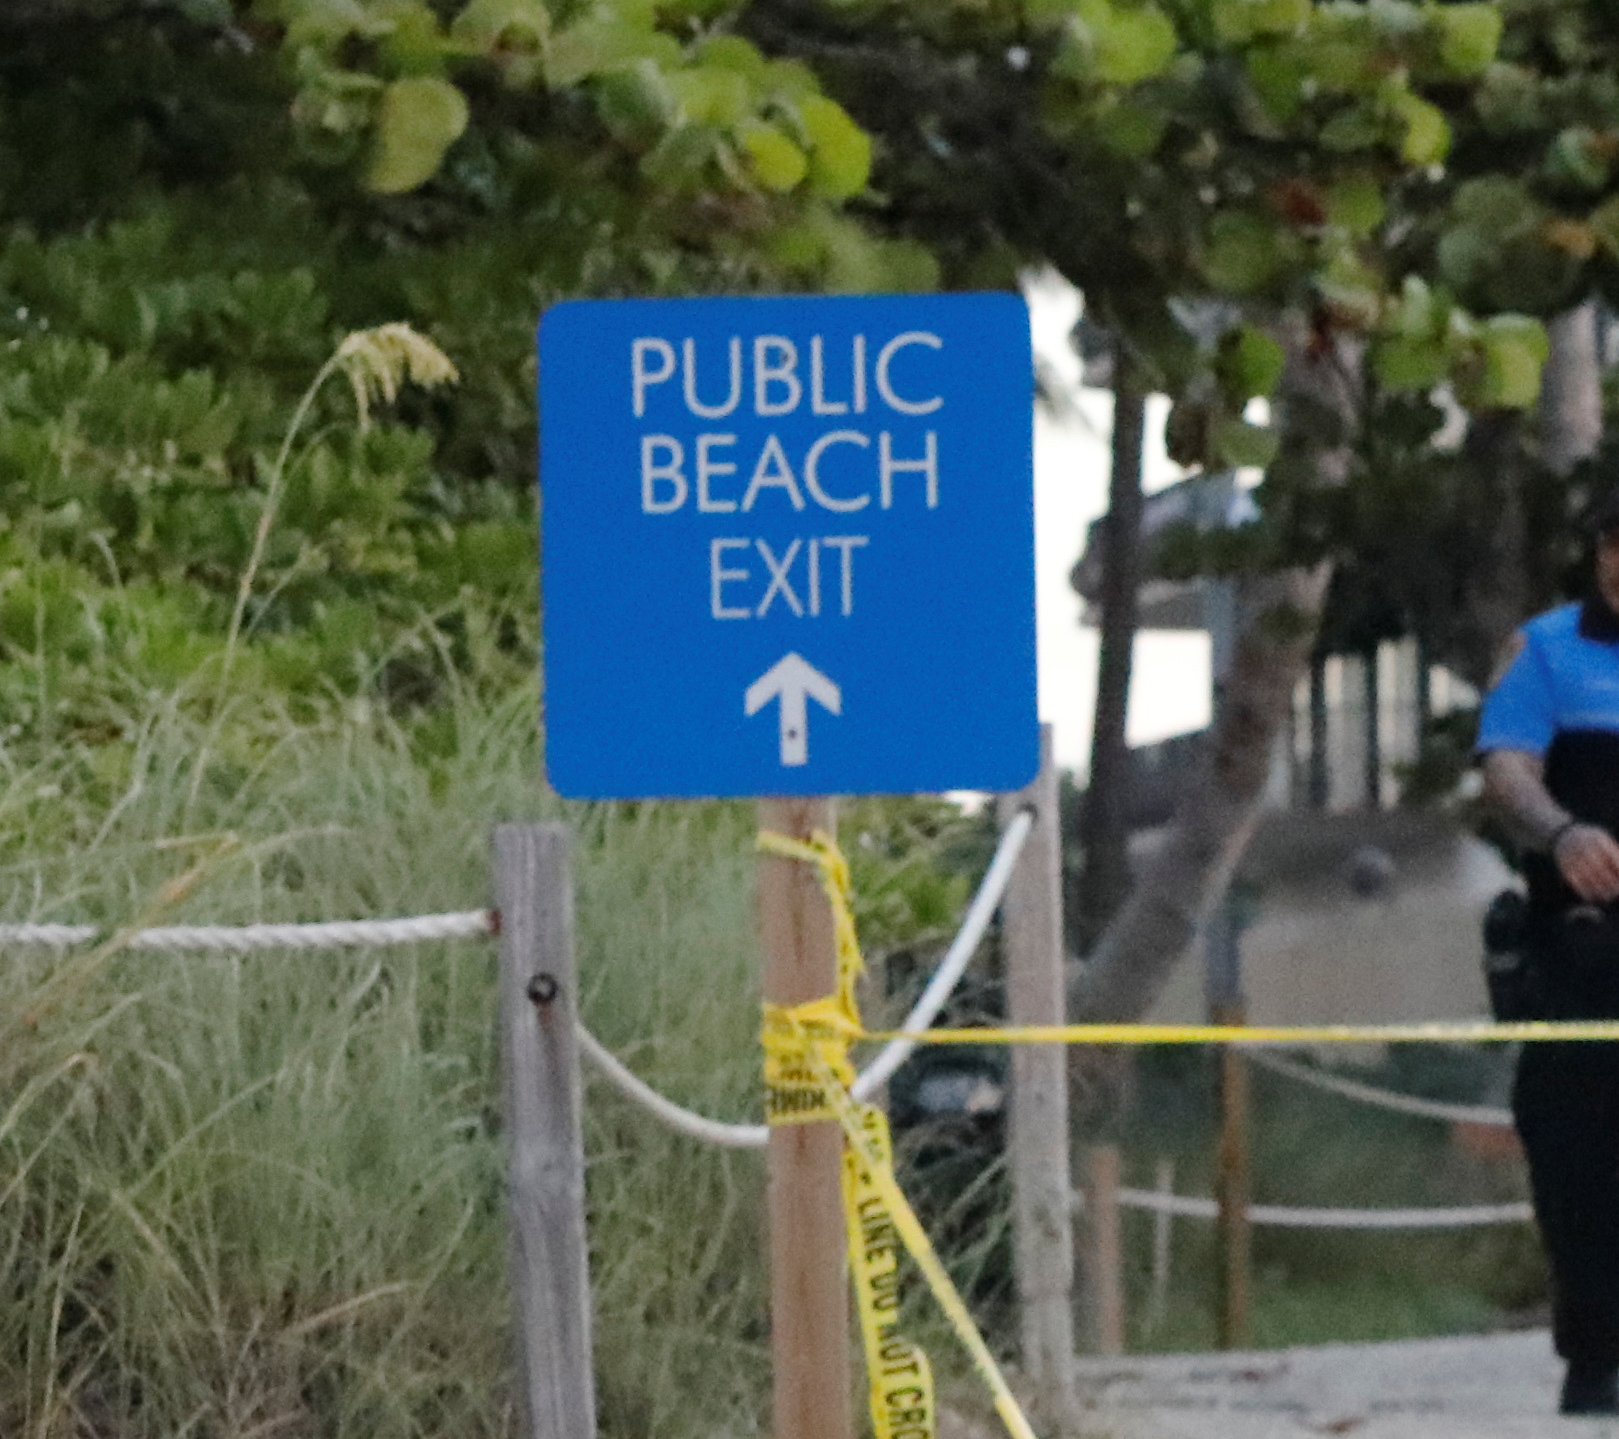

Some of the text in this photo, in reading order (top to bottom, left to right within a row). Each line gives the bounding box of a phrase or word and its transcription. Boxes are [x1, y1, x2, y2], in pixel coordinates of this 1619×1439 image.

[630, 331, 945, 418] PUBLIC
[641, 430, 939, 514] BEACH
[710, 535, 870, 619] EXIT
